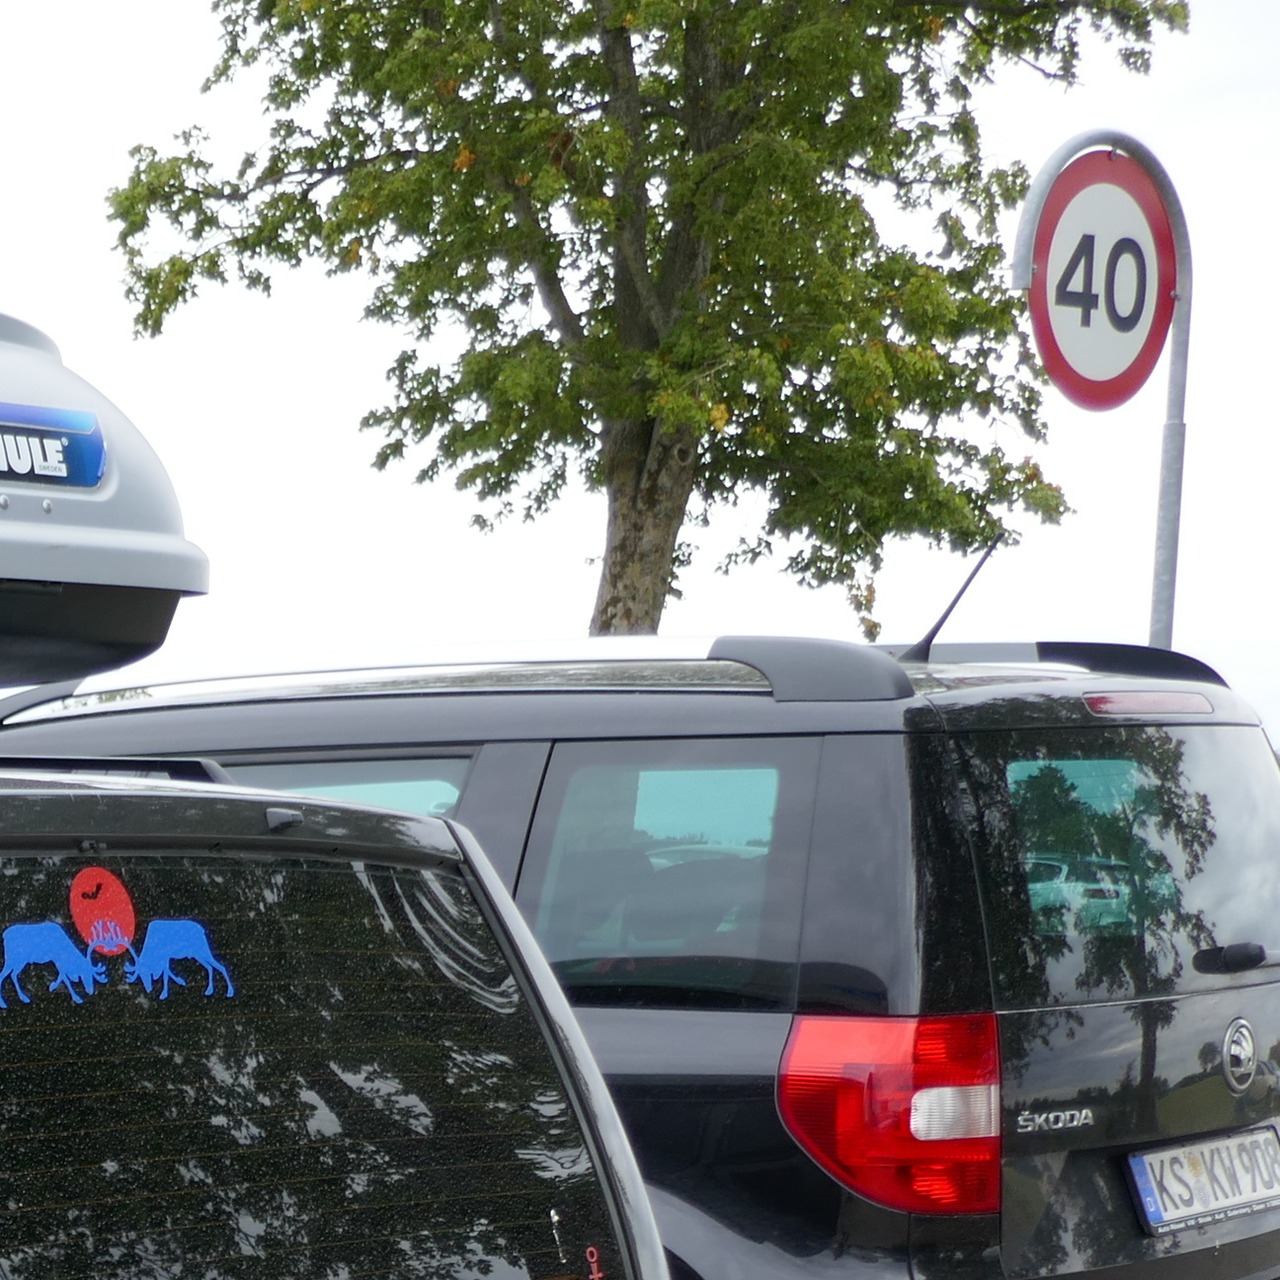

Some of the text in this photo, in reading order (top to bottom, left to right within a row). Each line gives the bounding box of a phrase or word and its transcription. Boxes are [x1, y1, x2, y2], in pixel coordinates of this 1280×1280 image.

[1054, 233, 1147, 334] 40
[38, 464, 63, 474] SWEDEN
[1016, 1108, 1095, 1134] ŠKODA
[1148, 1156, 1195, 1213] KS
[1200, 1145, 1243, 1202] KW
